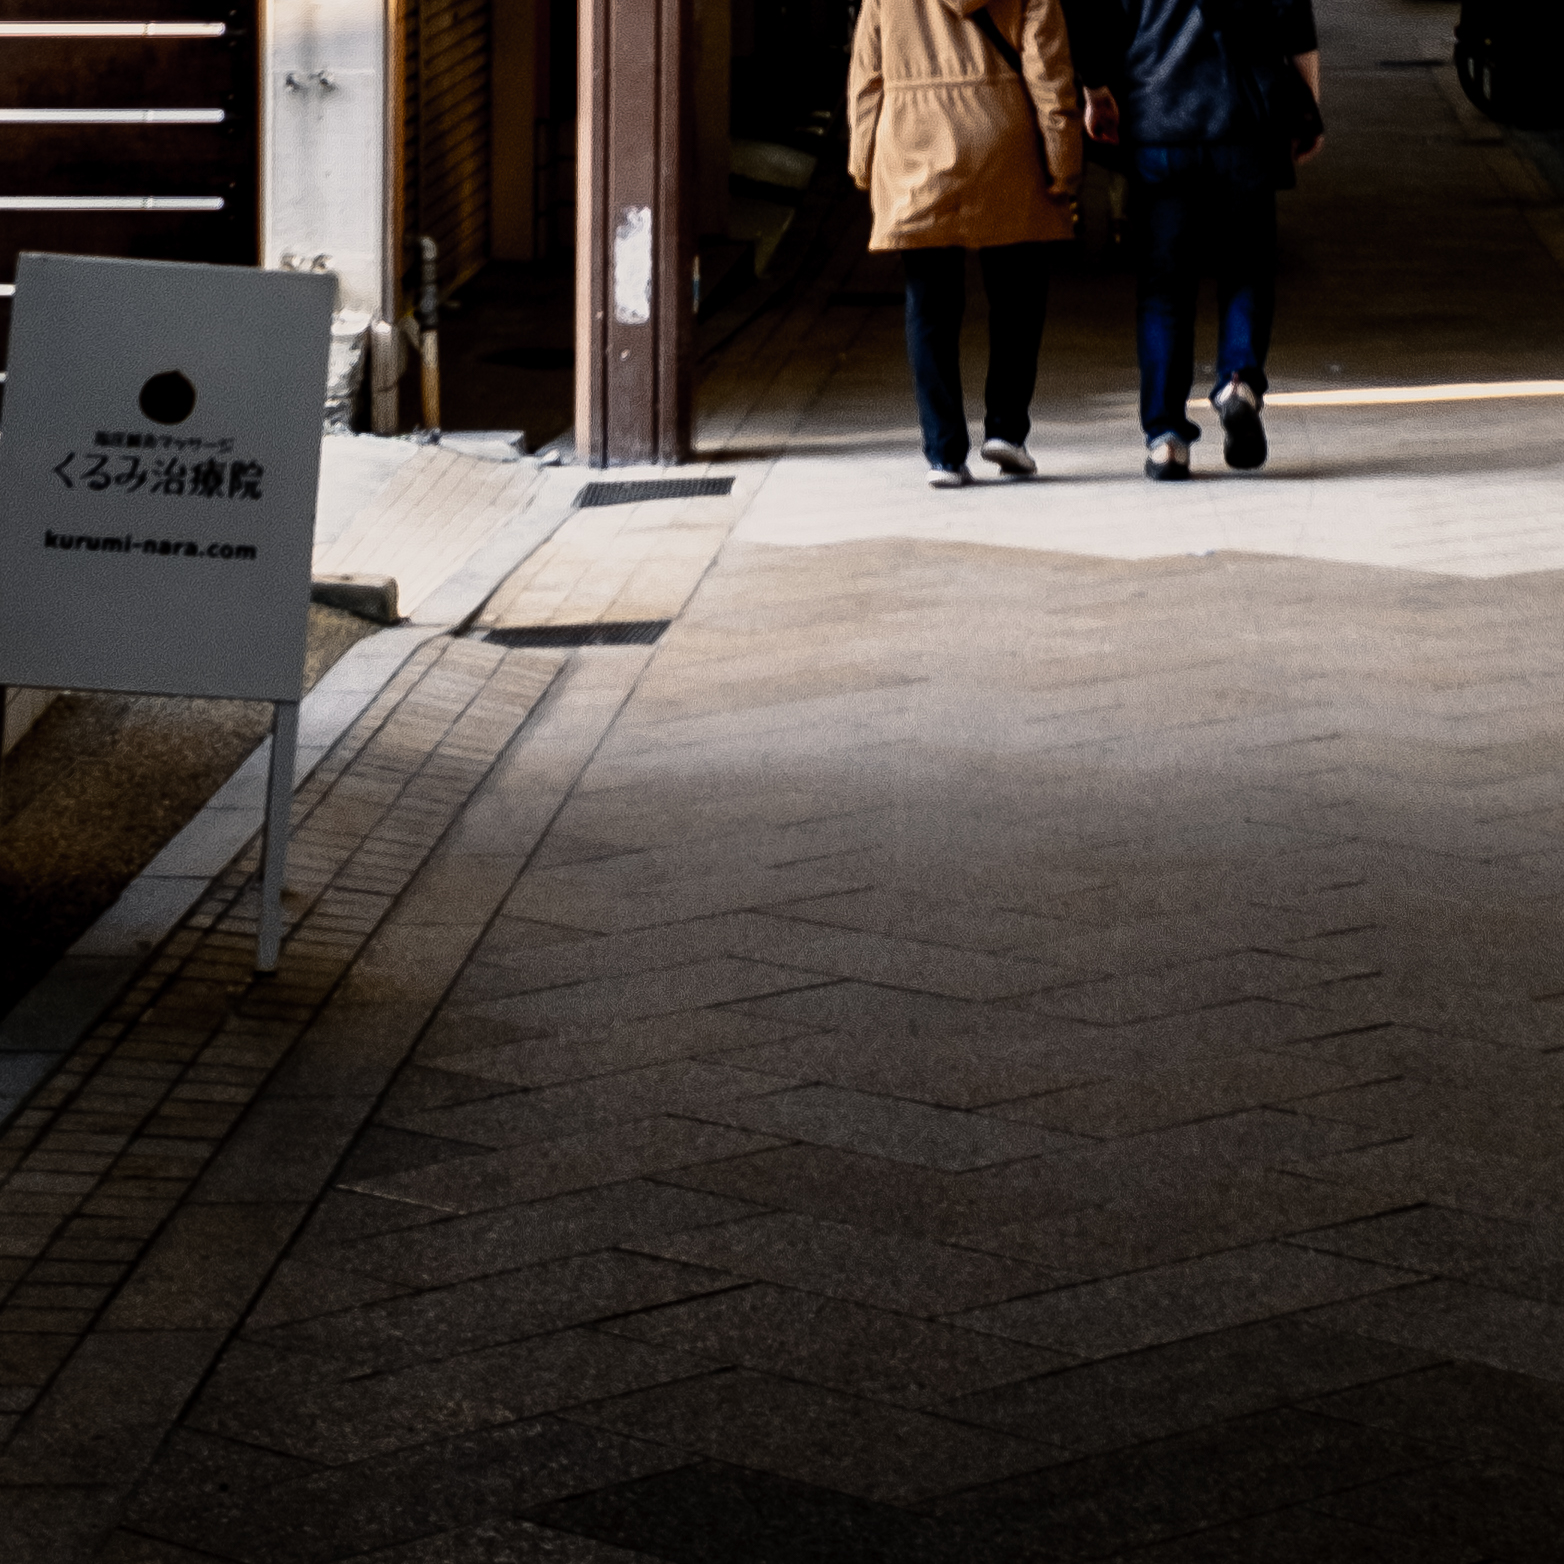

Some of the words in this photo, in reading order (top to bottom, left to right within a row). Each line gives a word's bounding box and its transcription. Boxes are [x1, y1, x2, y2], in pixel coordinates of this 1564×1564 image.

[54, 450, 264, 500] くるみ治療院
[45, 529, 257, 559] kurumi-nara.com
